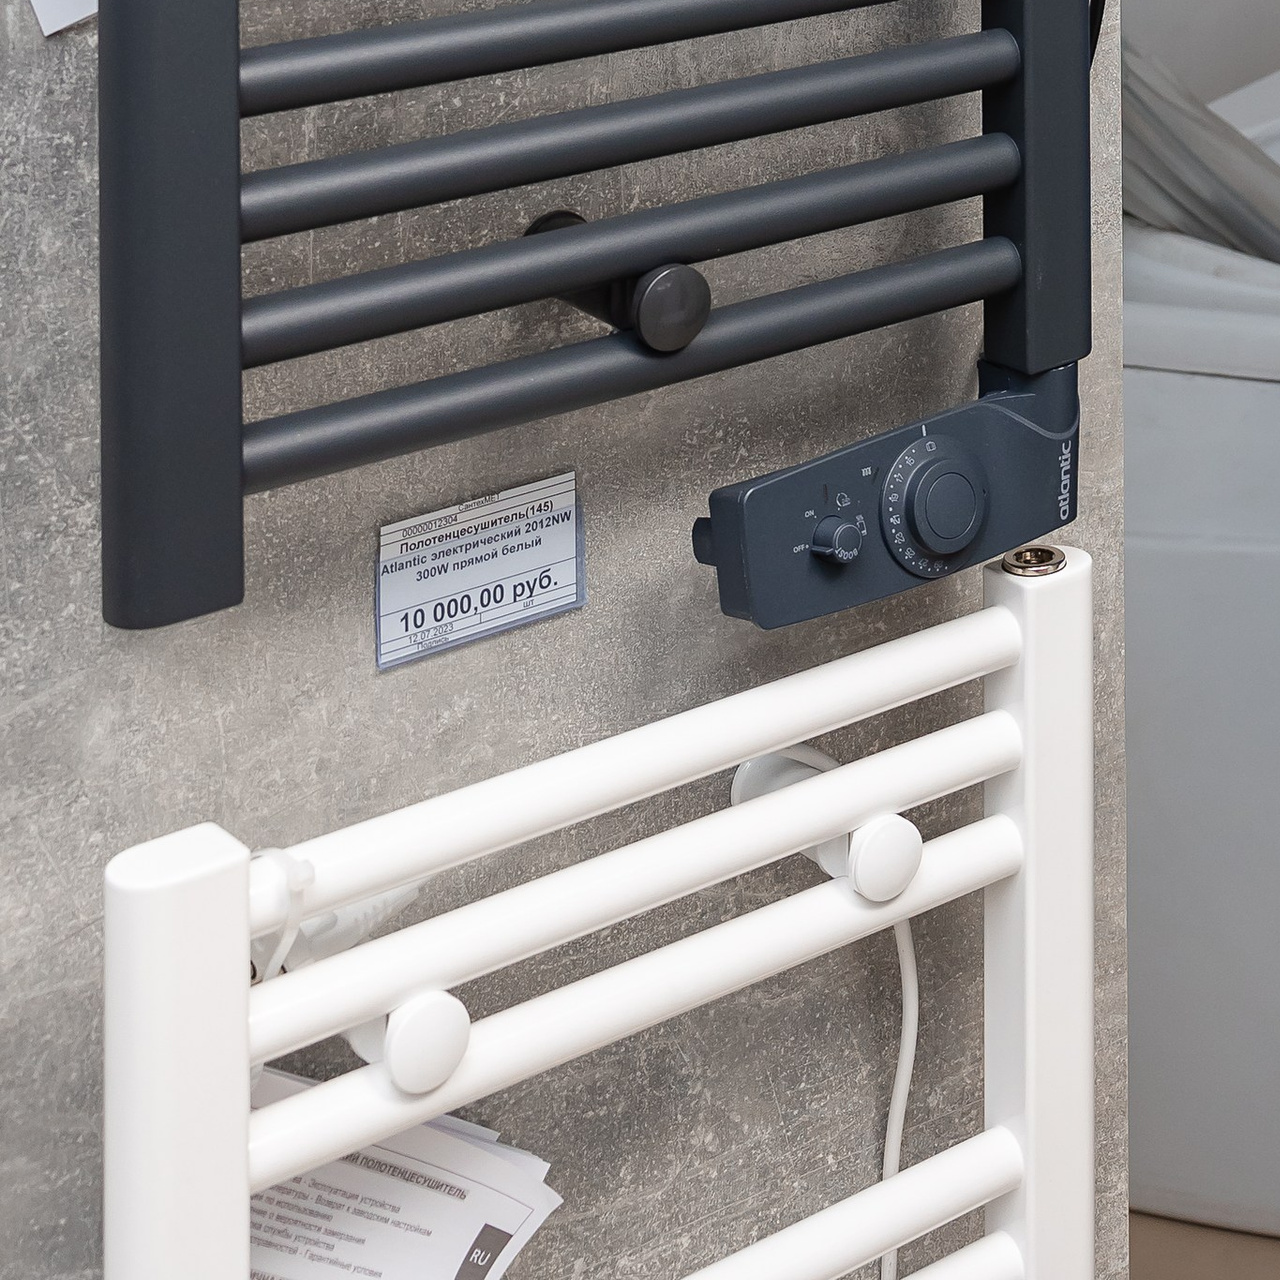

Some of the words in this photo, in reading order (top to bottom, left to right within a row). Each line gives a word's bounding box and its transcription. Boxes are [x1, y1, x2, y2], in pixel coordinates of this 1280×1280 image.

[1058, 440, 1071, 520] atlantic
[381, 555, 427, 576] Atlantic
[431, 526, 521, 561] электрический
[525, 510, 572, 534] 2012NW
[400, 499, 554, 554] Полотенцесушитель(145)
[416, 564, 449, 581] 300W
[452, 548, 498, 572] прямой
[502, 536, 542, 556] белый
[400, 608, 425, 632] 10
[433, 584, 504, 623] 000,00
[513, 568, 558, 602] руб.
[469, 1248, 491, 1266] RU
